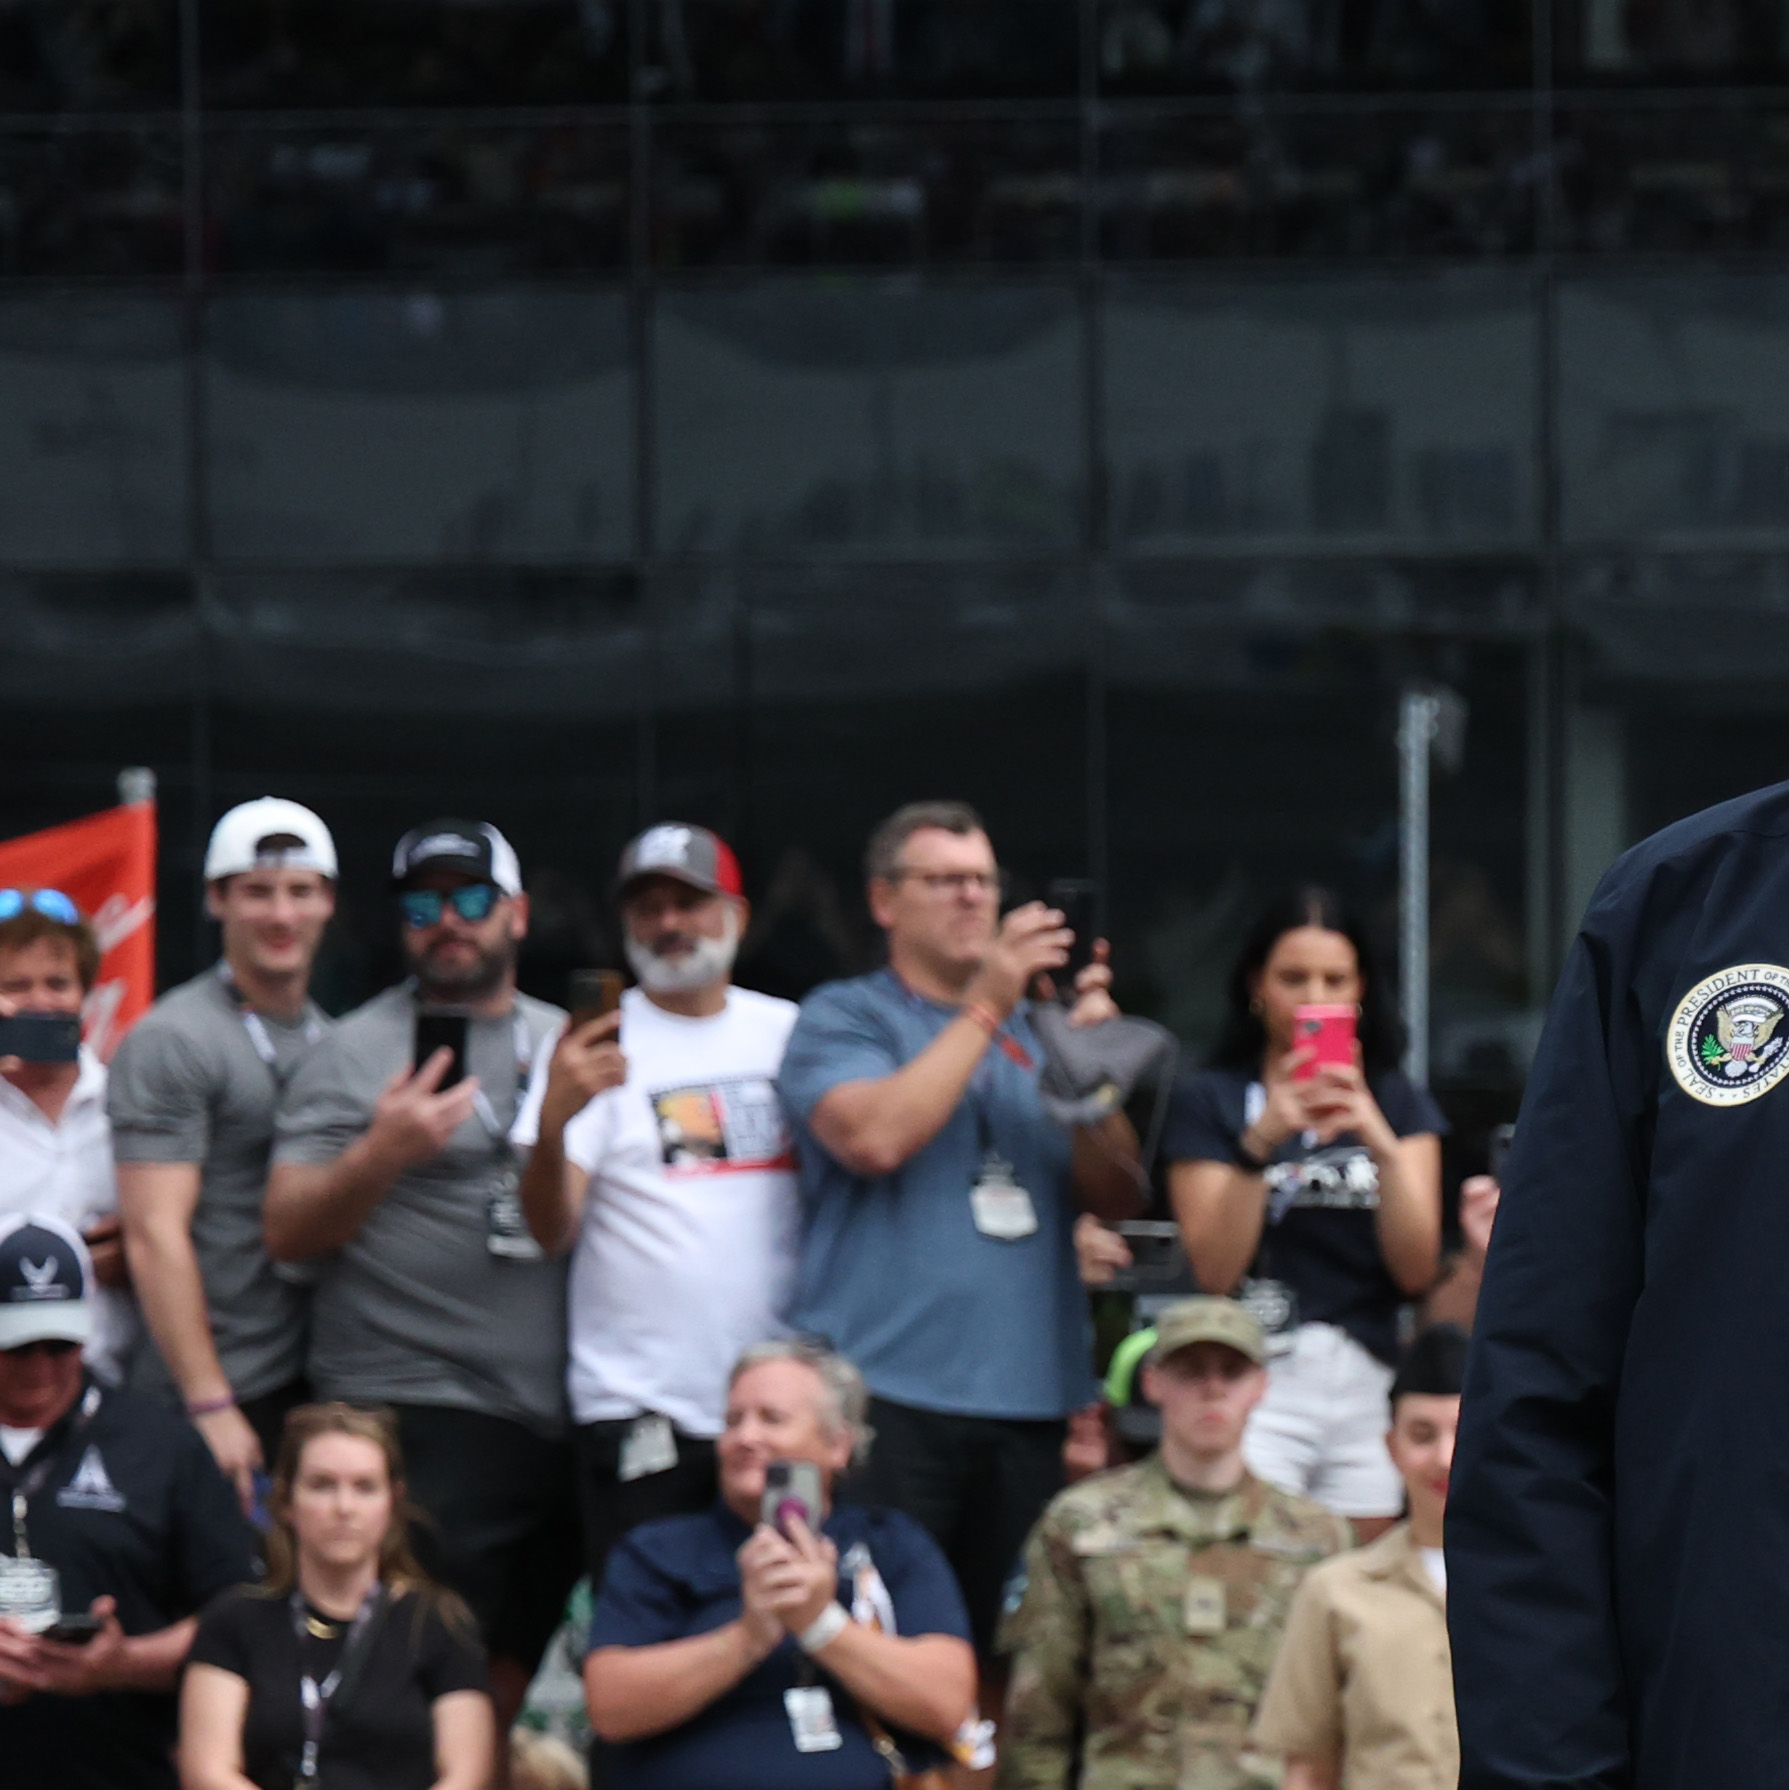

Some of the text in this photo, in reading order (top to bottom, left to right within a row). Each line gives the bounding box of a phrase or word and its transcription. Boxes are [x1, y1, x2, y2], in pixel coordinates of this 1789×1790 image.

[1764, 971, 1779, 981] OF
[1677, 969, 1761, 1028] PRESIDENT
[1674, 1031, 1685, 1054] THE
[1676, 1055, 1687, 1068] OF
[1682, 1066, 1717, 1099] SEAL
